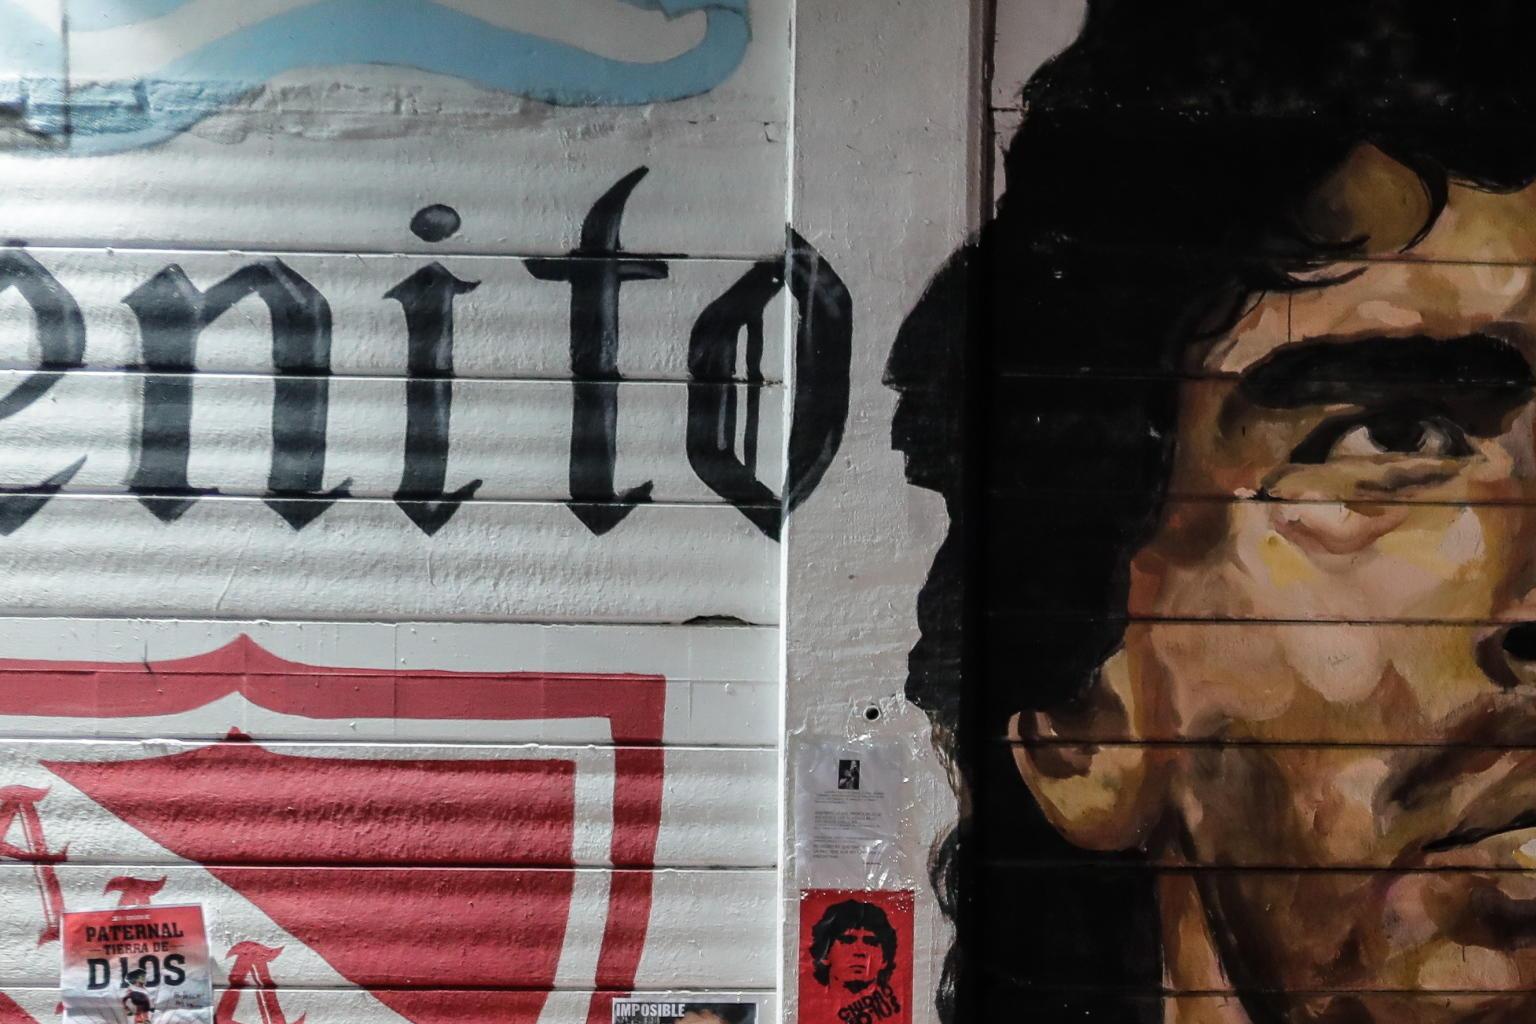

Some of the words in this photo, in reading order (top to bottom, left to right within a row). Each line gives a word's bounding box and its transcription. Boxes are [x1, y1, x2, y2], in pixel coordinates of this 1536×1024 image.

[85, 921, 185, 942] PATERNAL
[103, 942, 149, 955] TIERRA
[153, 941, 170, 952] DE
[616, 1003, 686, 1017] IMPOSIBLE
